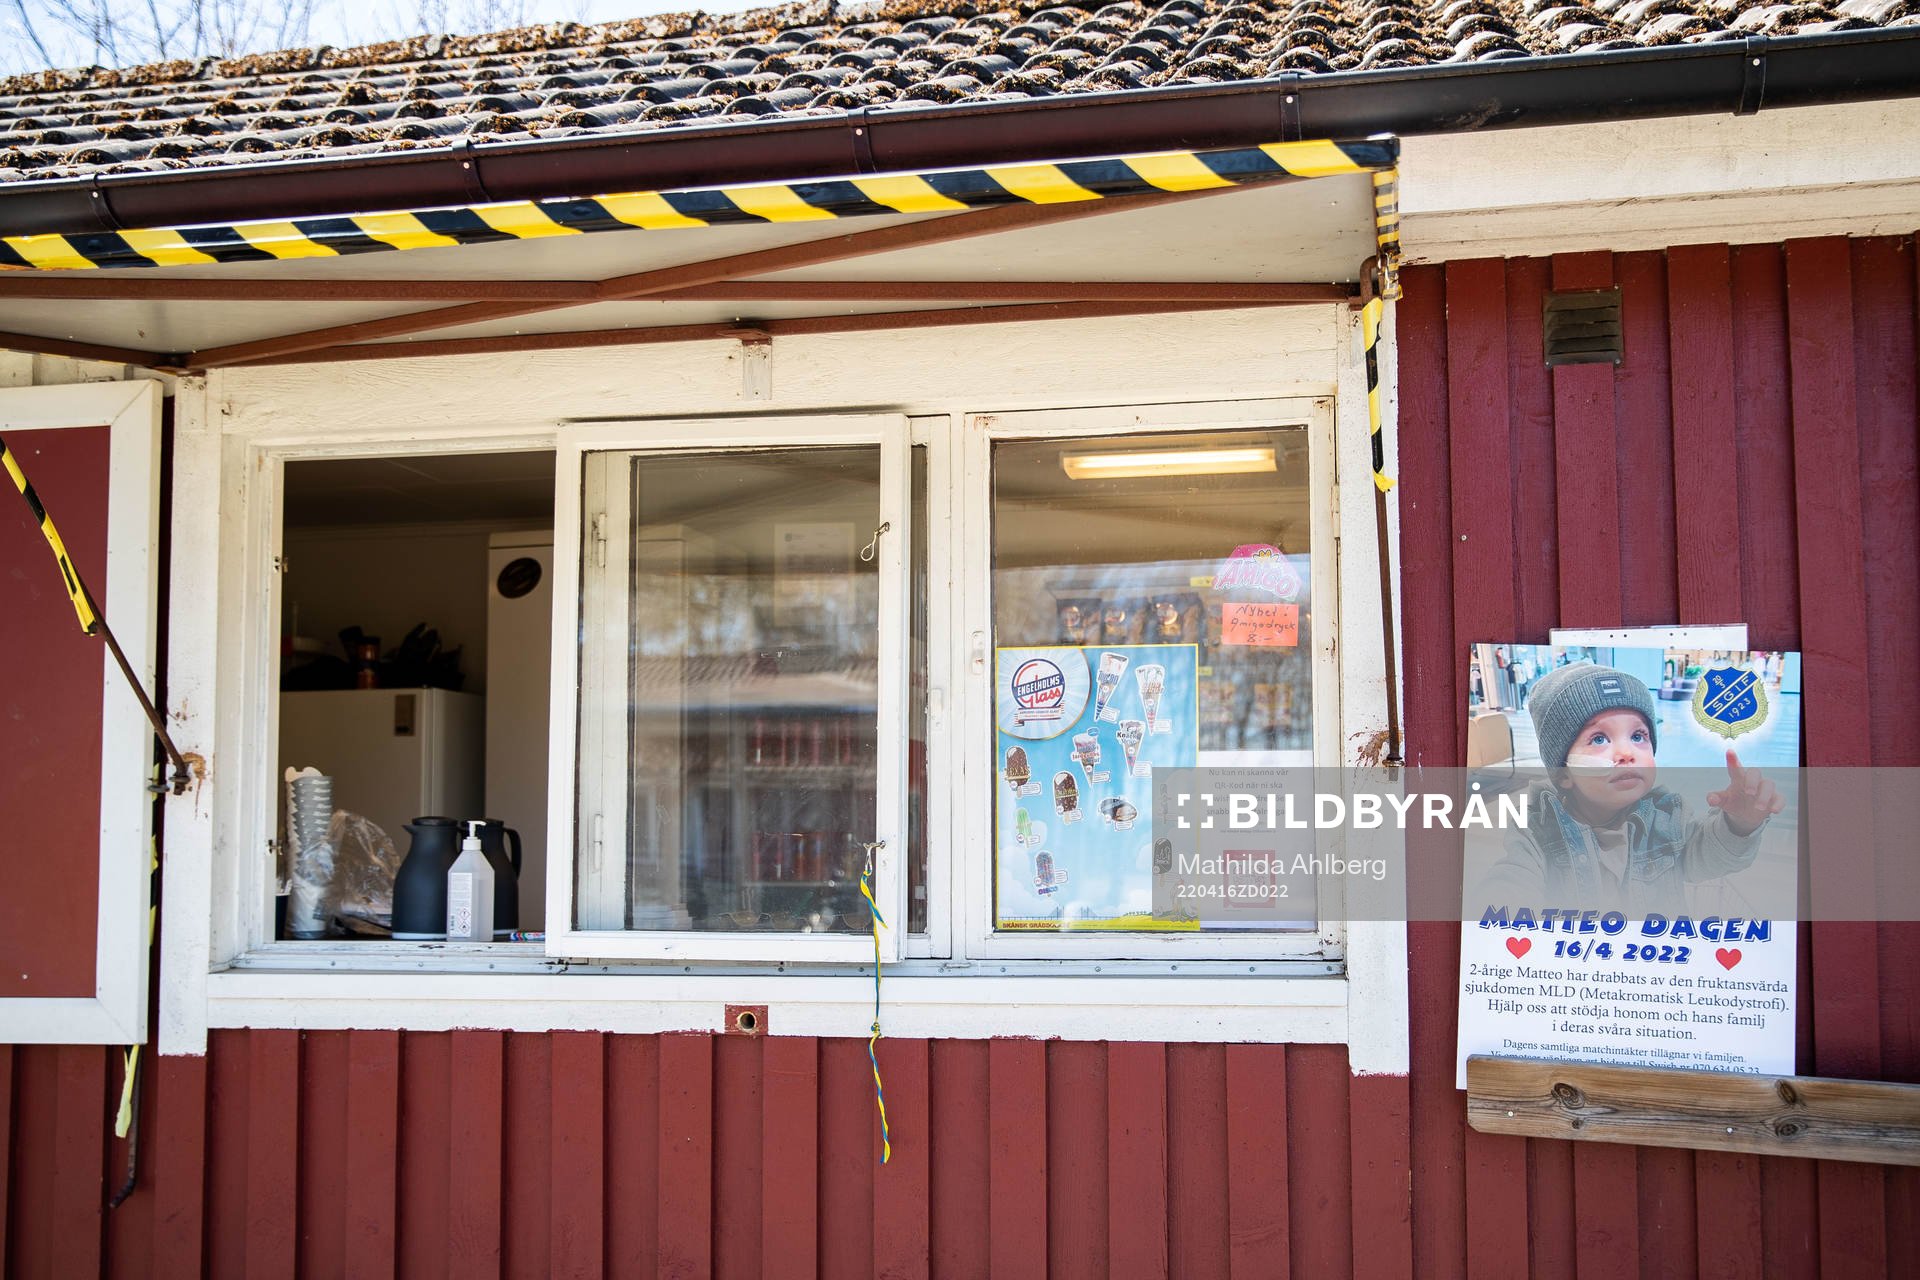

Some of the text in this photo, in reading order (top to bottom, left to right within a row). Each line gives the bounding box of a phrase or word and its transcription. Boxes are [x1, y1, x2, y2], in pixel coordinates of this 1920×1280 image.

[1017, 675, 1060, 697] ENGELHOLMS
[1269, 781, 1283, 789] ska
[1479, 904, 1772, 942] MATTEO DAGEN
[1554, 939, 1692, 964] 16/4 2022
[1470, 963, 1788, 993] 2-årige Matteo har drabbats av den fruktansvärda
[1465, 982, 1789, 1012] sjukdomen MLD (Metakromatisk Leukodystrofi).
[1488, 999, 1765, 1030] Hjälp oss att stödja honom och hans familj
[1552, 1020, 1697, 1040] i deras svåra situation.
[1503, 1039, 1538, 1050] Dagens
[1540, 1042, 1580, 1054] samtliga
[1582, 1045, 1648, 1057] matchintäkter
[1650, 1048, 1690, 1060] tillägnar
[1693, 1051, 1702, 1060] vi
